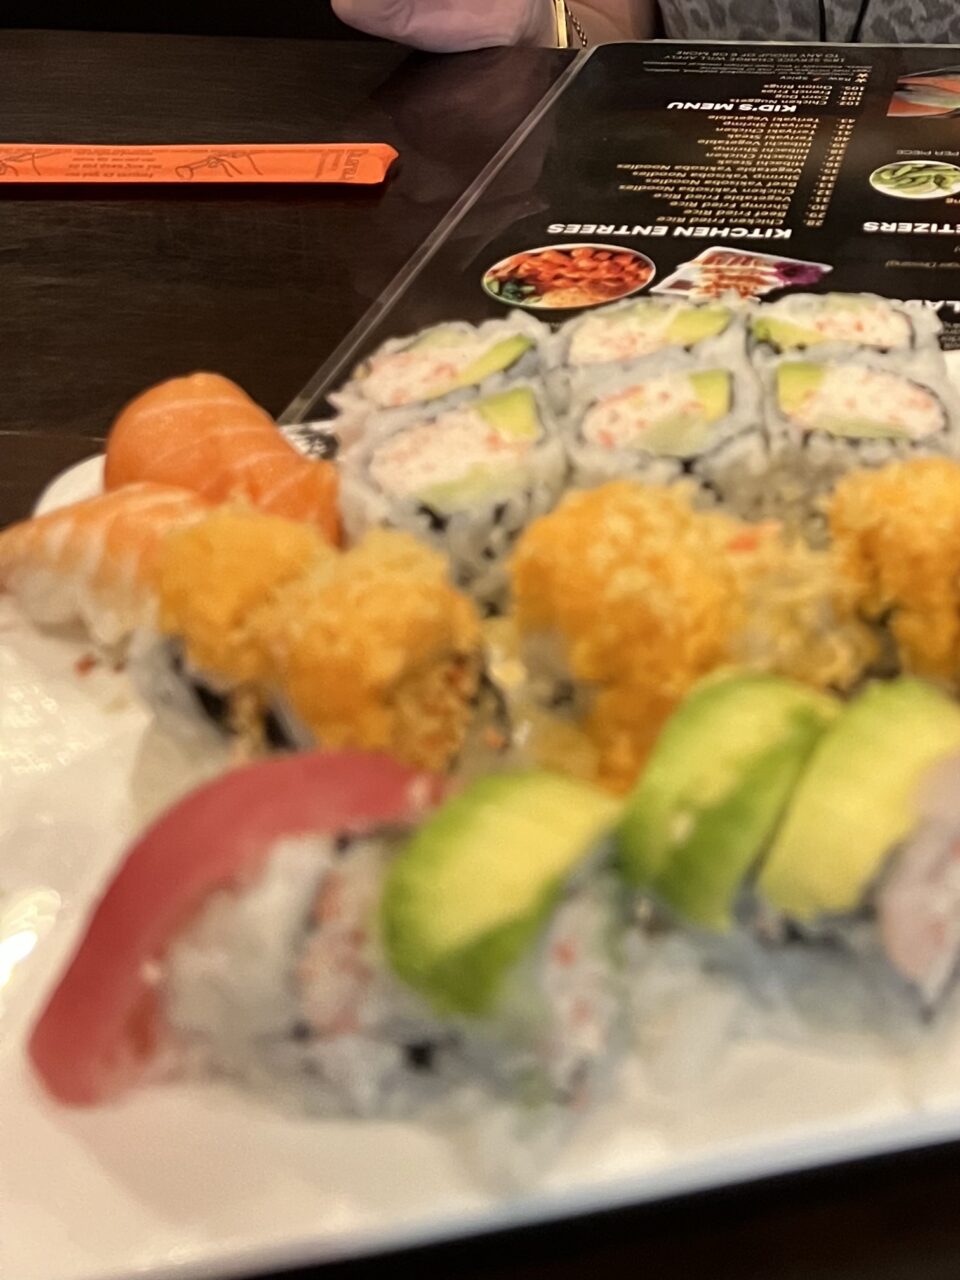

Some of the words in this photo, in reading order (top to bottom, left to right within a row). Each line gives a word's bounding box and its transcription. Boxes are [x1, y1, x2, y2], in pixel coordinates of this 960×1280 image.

[666, 102, 734, 110] MENU
[738, 104, 796, 112] KID'S
[723, 194, 791, 202] Vegetable
[740, 202, 788, 210] Shrimp
[548, 223, 668, 236] ENTREES
[672, 226, 792, 239] KITCHEN
